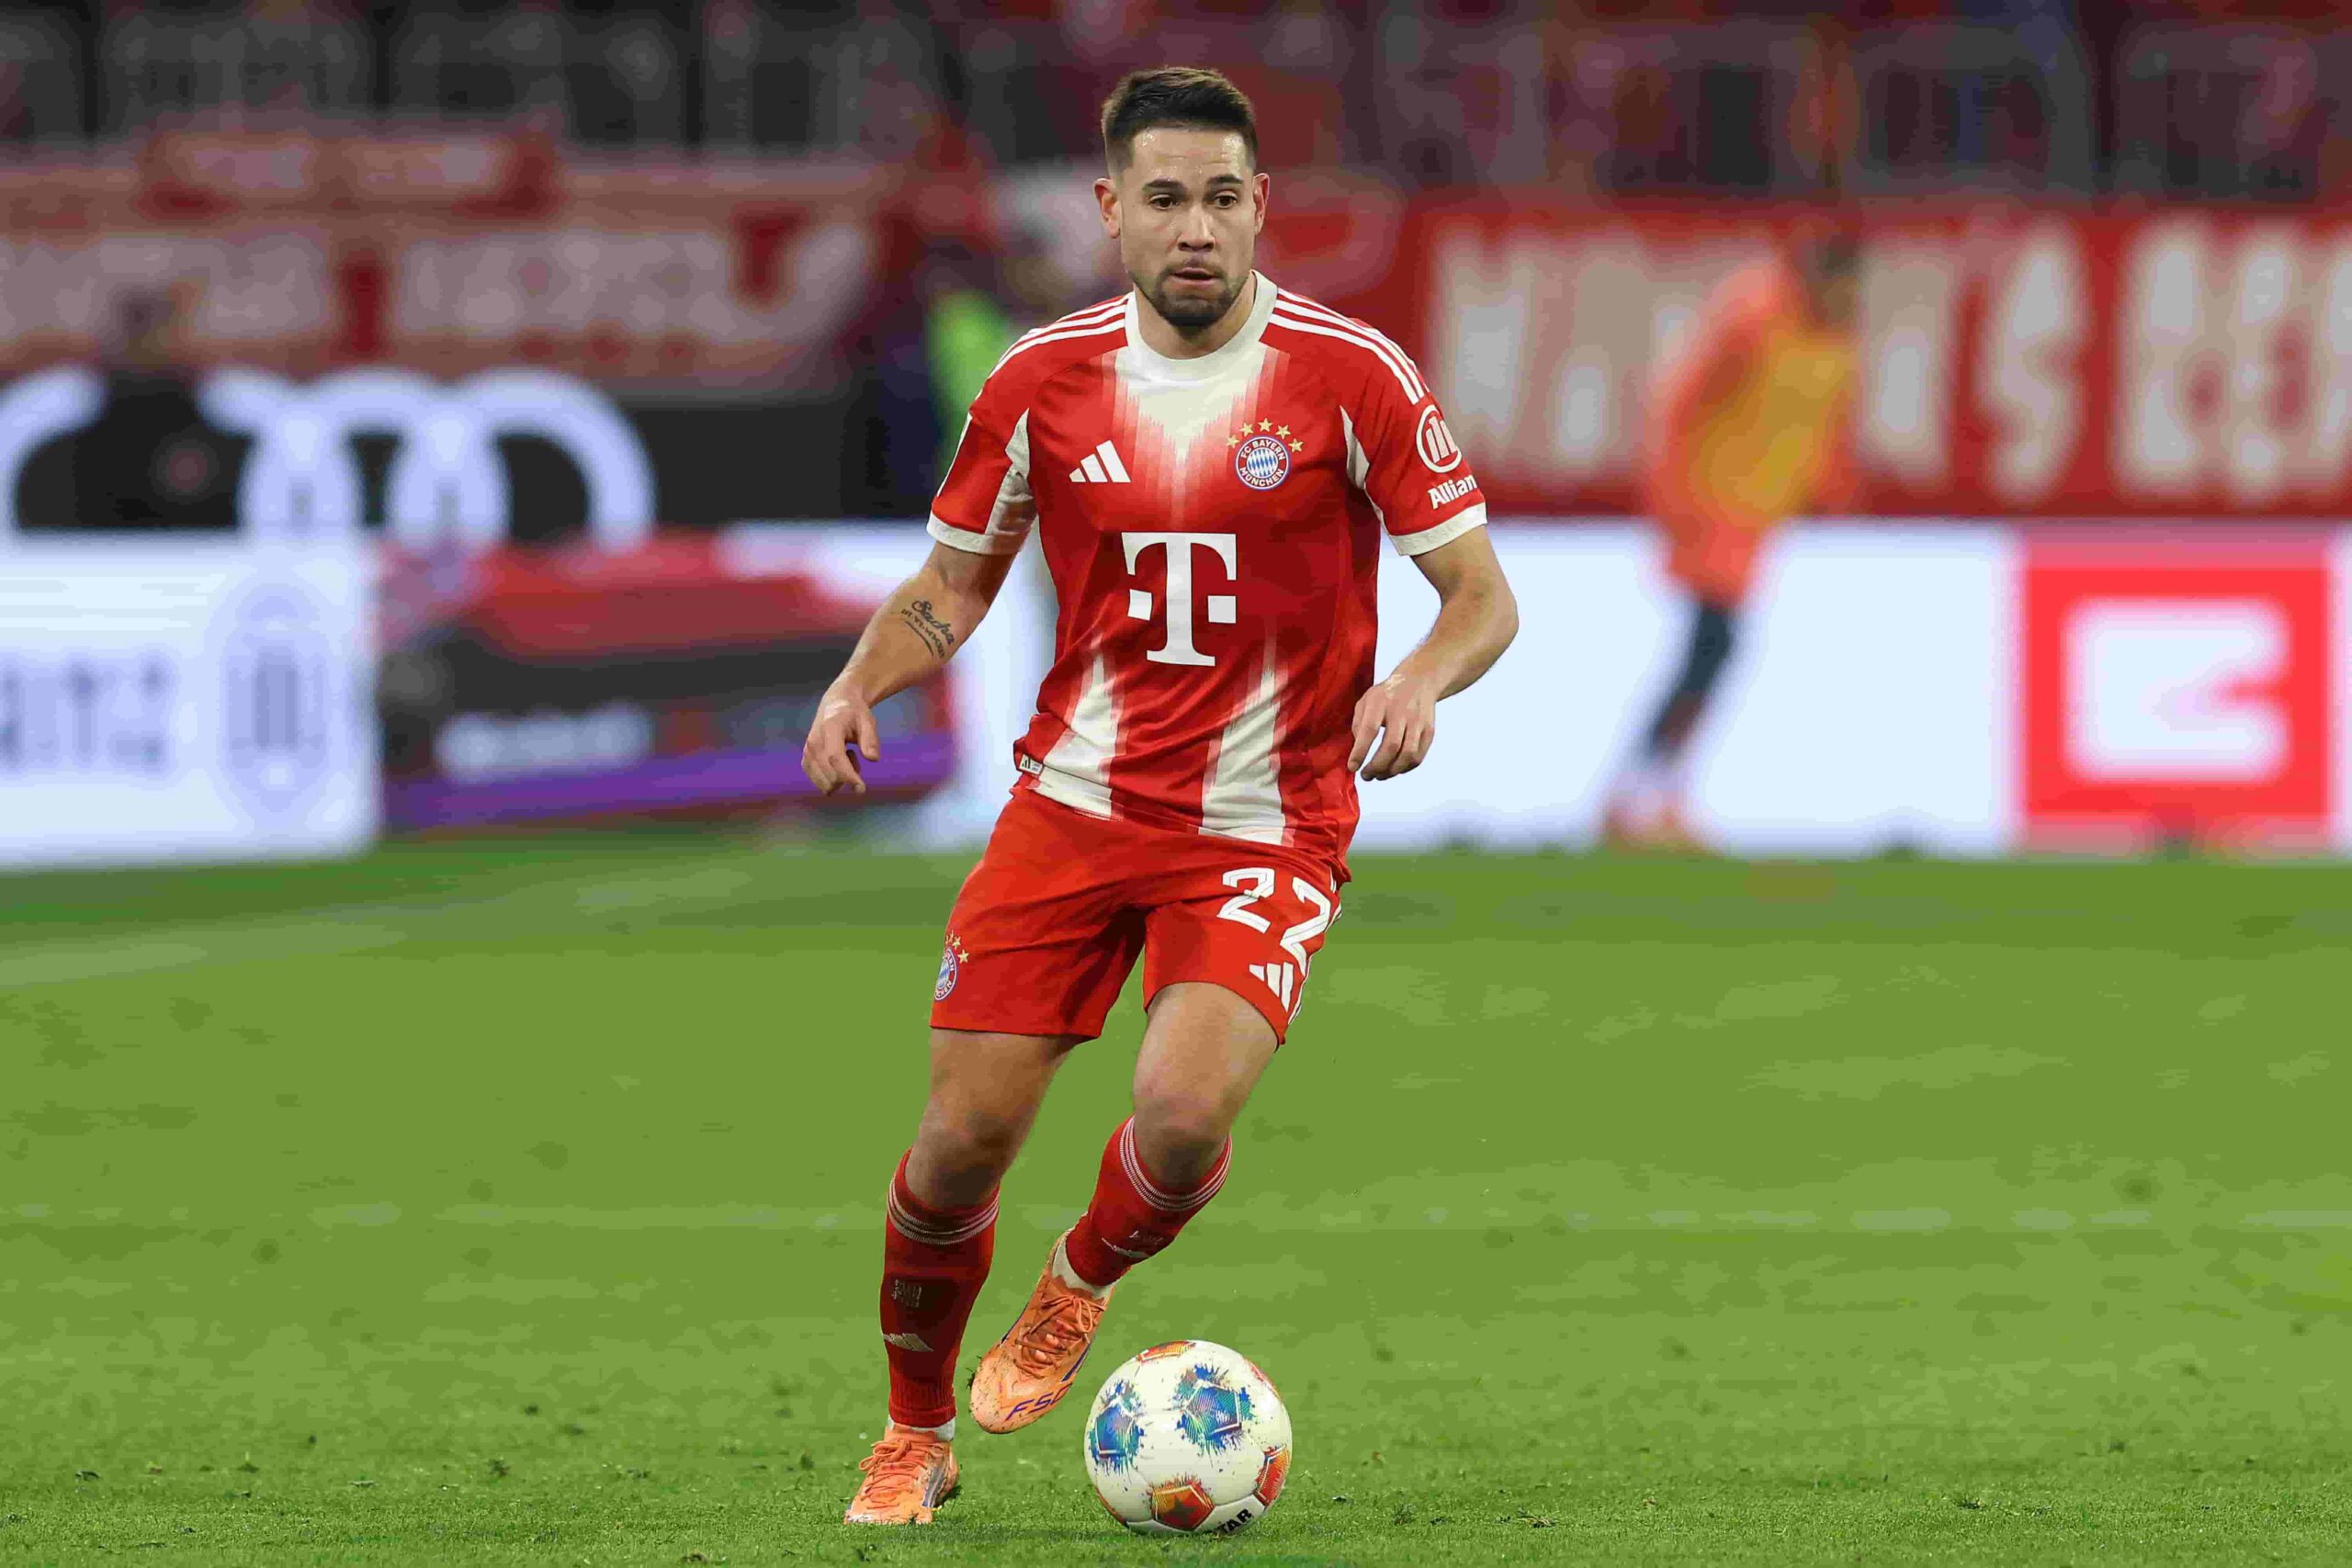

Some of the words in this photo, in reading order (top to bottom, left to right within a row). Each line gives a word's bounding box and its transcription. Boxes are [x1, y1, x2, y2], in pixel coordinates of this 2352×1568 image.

[1240, 446, 1252, 459] FC
[1251, 440, 1286, 460] BAYERN
[1216, 867, 1331, 977] 22
[1212, 1508, 1253, 1536] TAR
